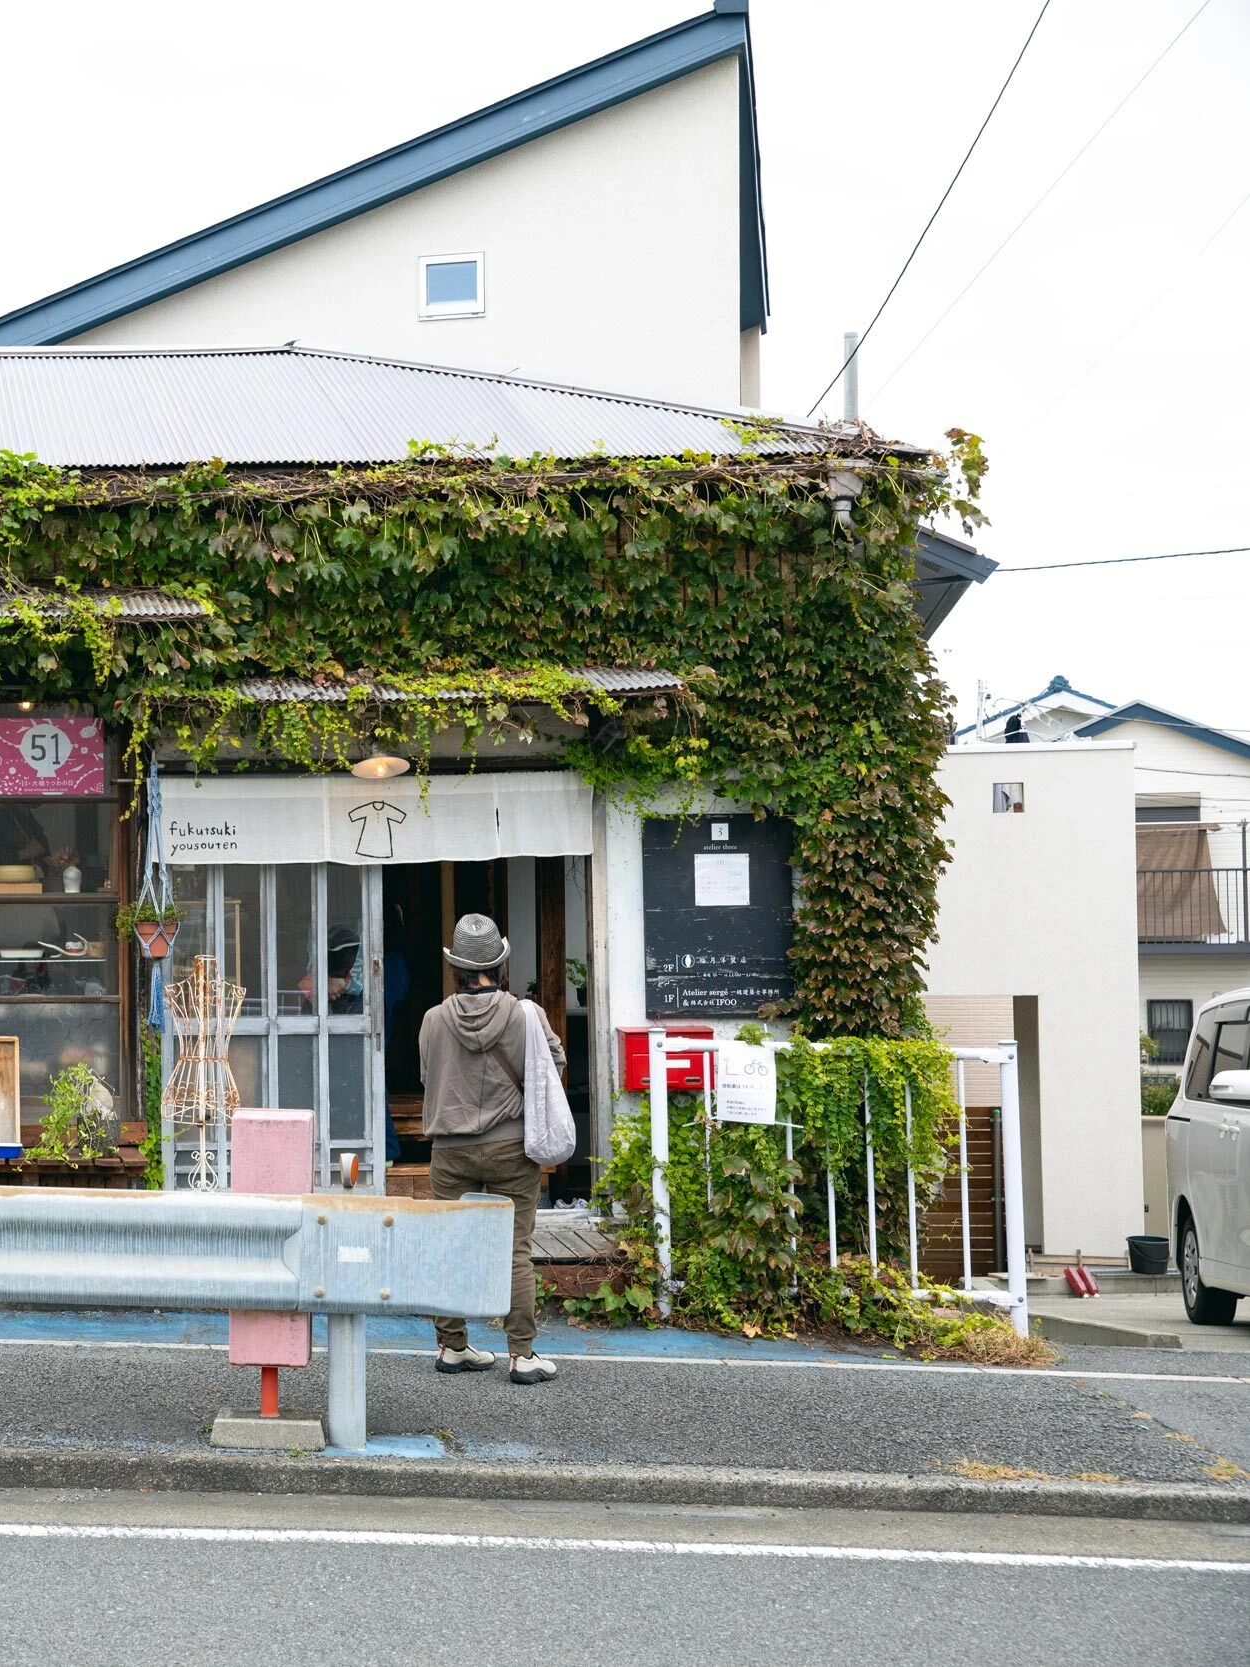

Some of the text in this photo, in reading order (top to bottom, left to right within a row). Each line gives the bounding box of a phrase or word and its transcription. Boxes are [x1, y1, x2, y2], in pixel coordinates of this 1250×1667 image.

[31, 733, 61, 765] 51
[169, 821, 236, 836] fukutsuki
[171, 842, 237, 857] yousouten
[663, 964, 674, 972] 2F
[709, 988, 729, 997] sergé
